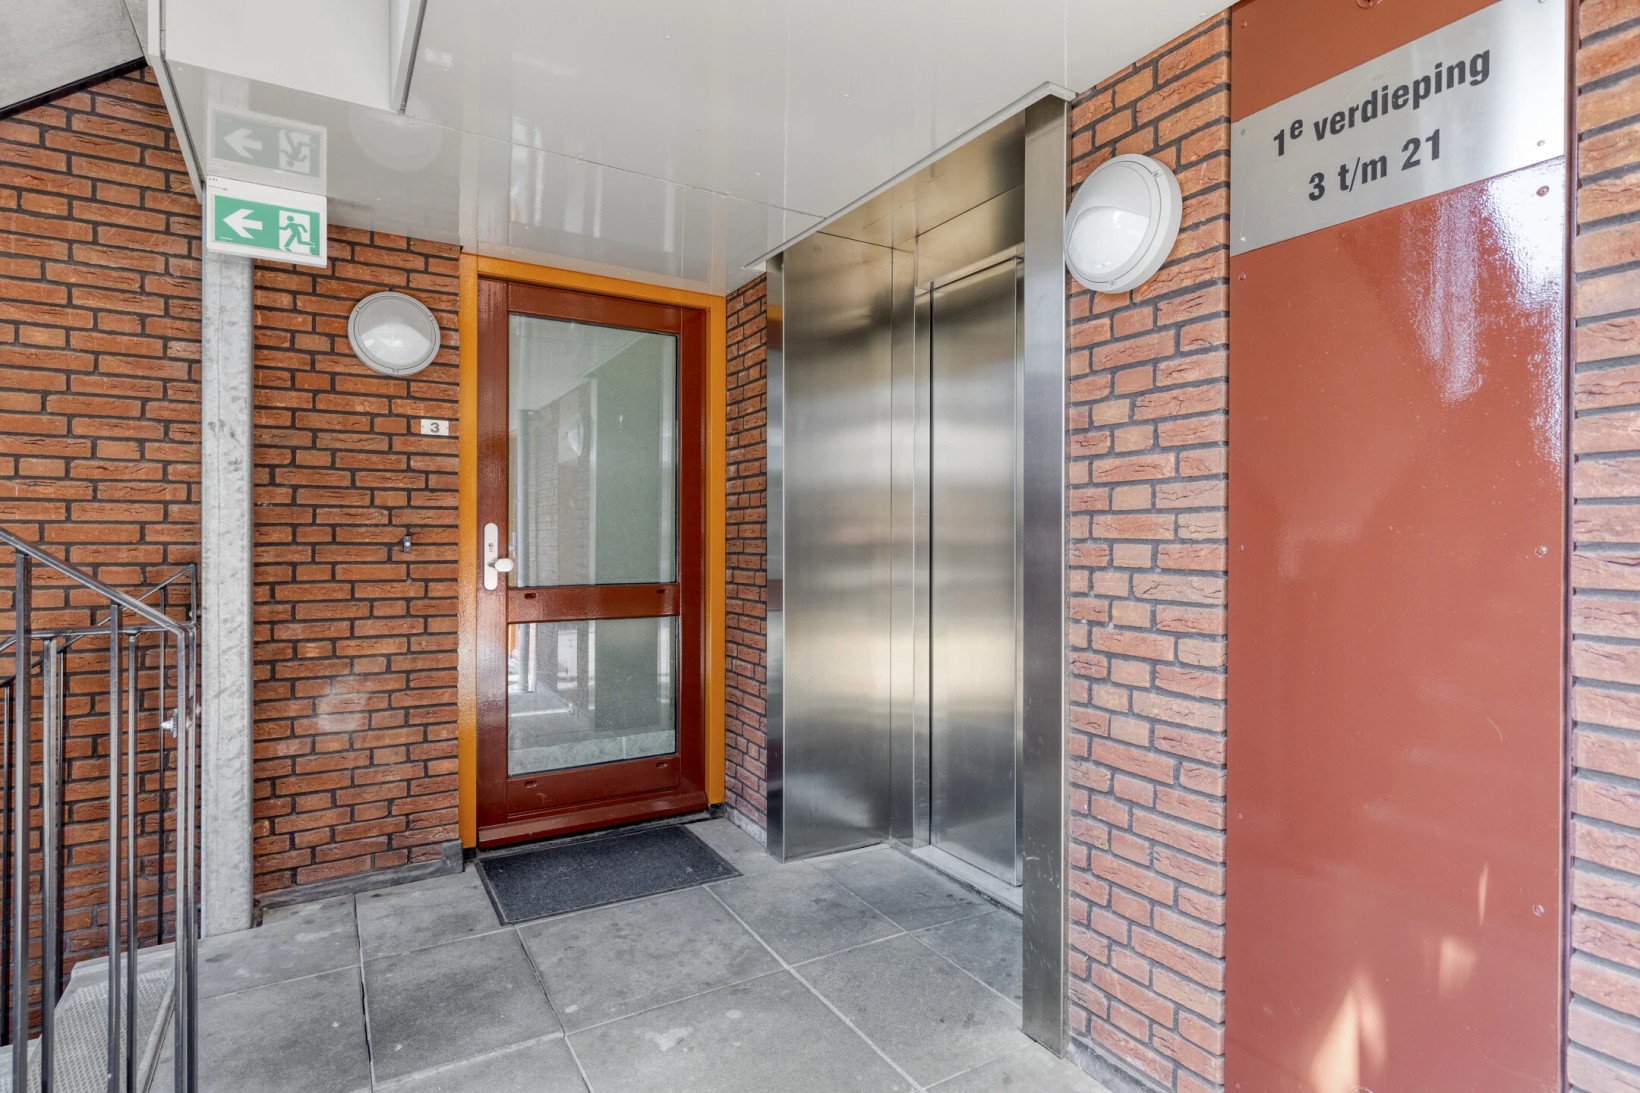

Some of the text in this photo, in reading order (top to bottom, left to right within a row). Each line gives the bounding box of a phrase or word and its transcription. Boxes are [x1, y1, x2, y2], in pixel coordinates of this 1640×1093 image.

[1313, 49, 1490, 141] verdieping
[1308, 128, 1440, 201] 3 t/m 21
[430, 422, 440, 433] 3
